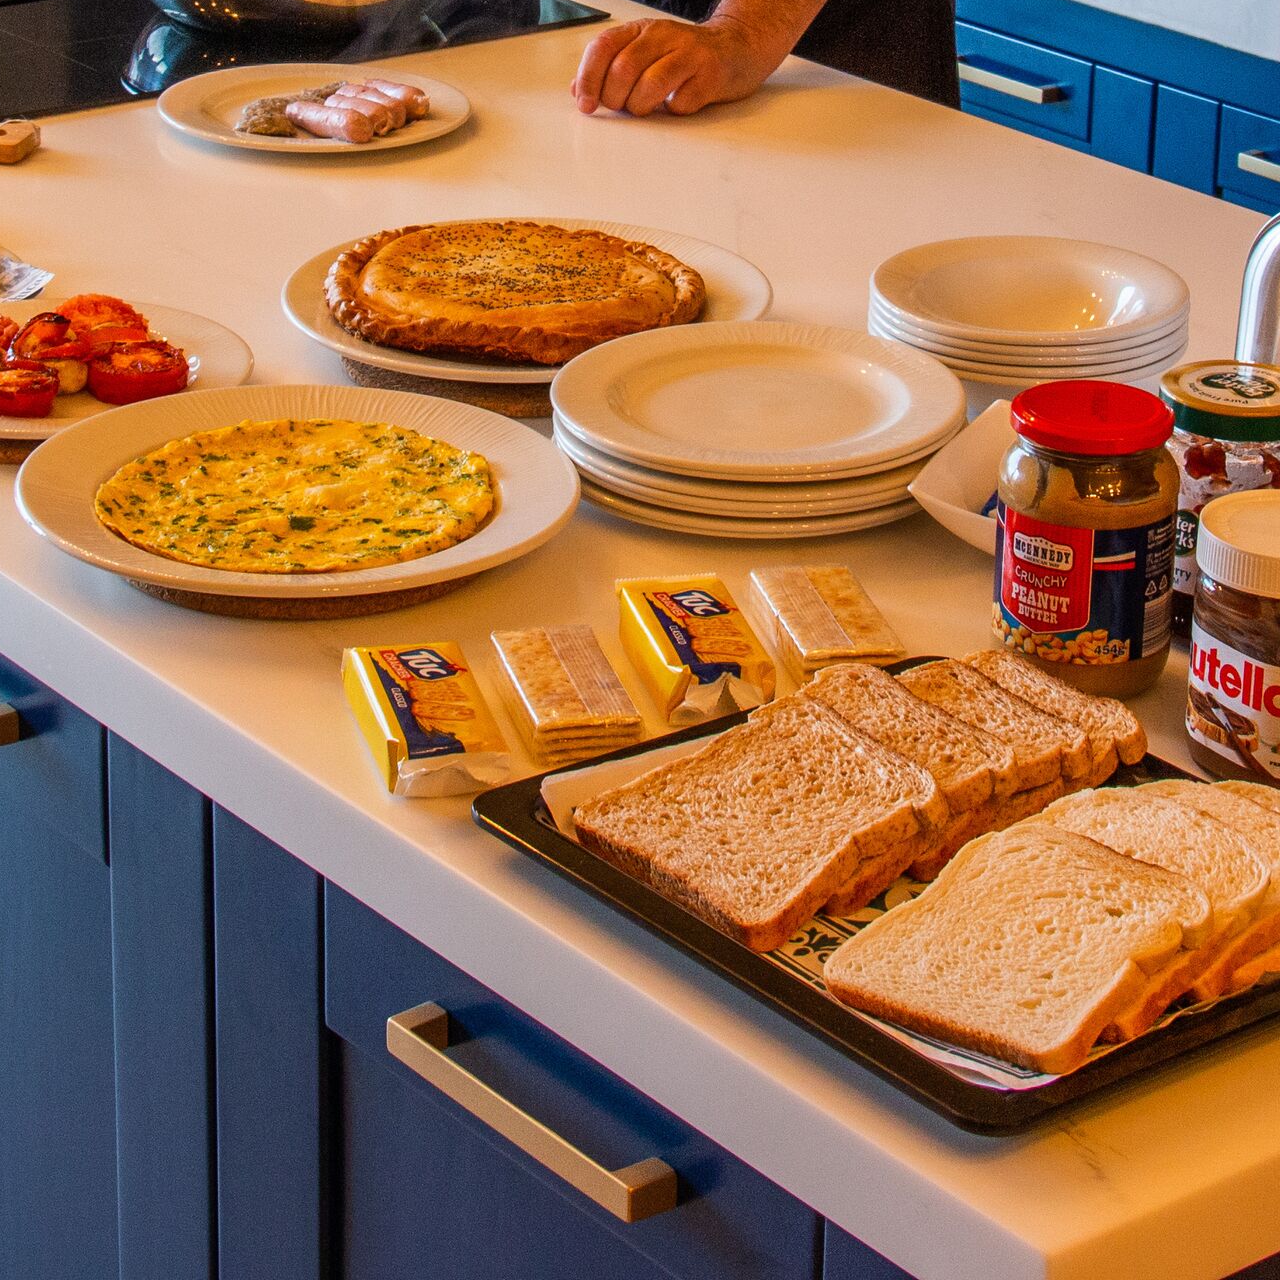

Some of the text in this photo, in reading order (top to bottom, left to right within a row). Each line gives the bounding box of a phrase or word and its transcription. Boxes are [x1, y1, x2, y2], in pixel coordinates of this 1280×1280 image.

[1015, 565, 1068, 589] CRUNCHY
[656, 593, 687, 617] CRACKER
[672, 591, 720, 616] TUC
[1011, 581, 1071, 614] PEANUT
[1017, 603, 1059, 625] BUTTER
[1093, 642, 1126, 658] 454g
[382, 651, 412, 680] CRACKER
[400, 650, 449, 678] TUC
